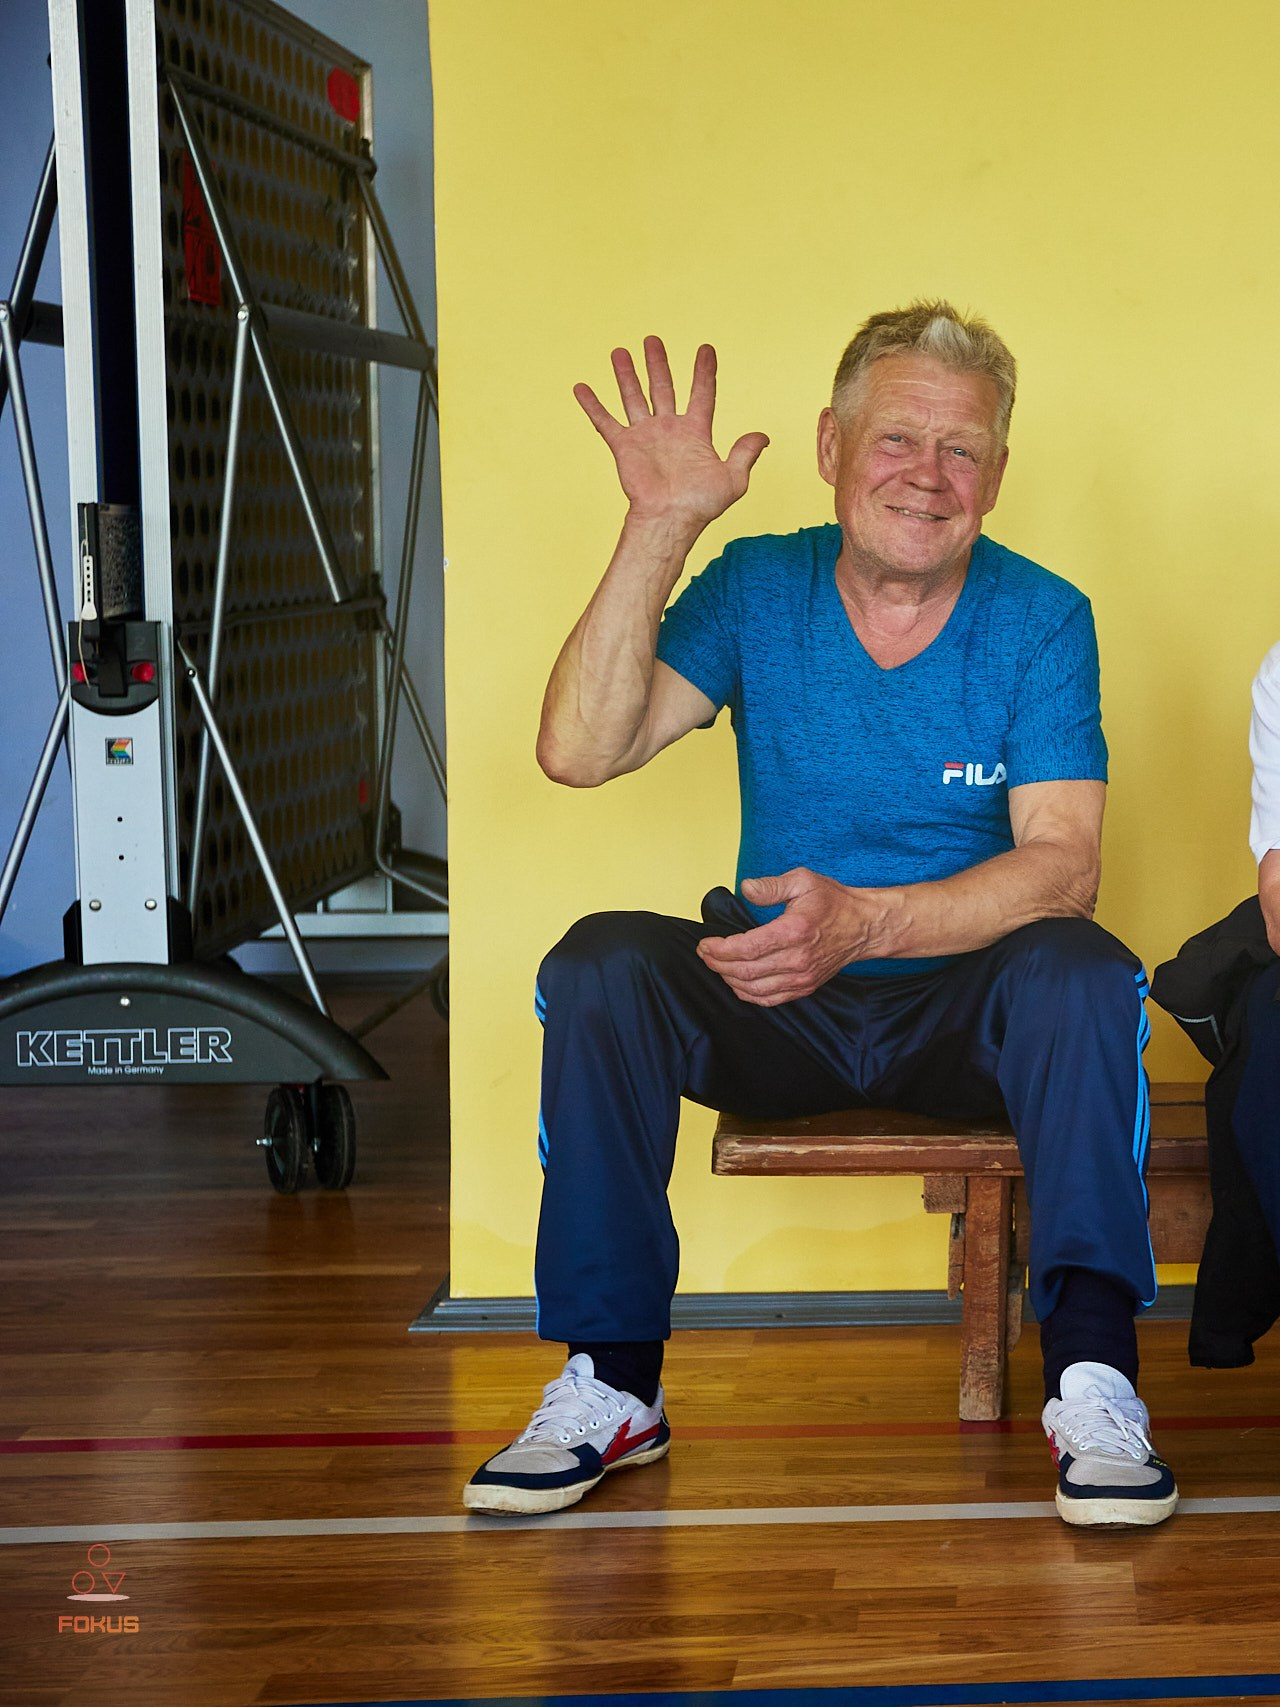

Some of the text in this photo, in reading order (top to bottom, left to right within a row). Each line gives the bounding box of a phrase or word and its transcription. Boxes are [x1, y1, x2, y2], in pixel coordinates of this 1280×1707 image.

[942, 762, 1007, 785] FILA
[16, 1027, 233, 1067] KETTLER
[87, 1065, 164, 1075] Made in Germany
